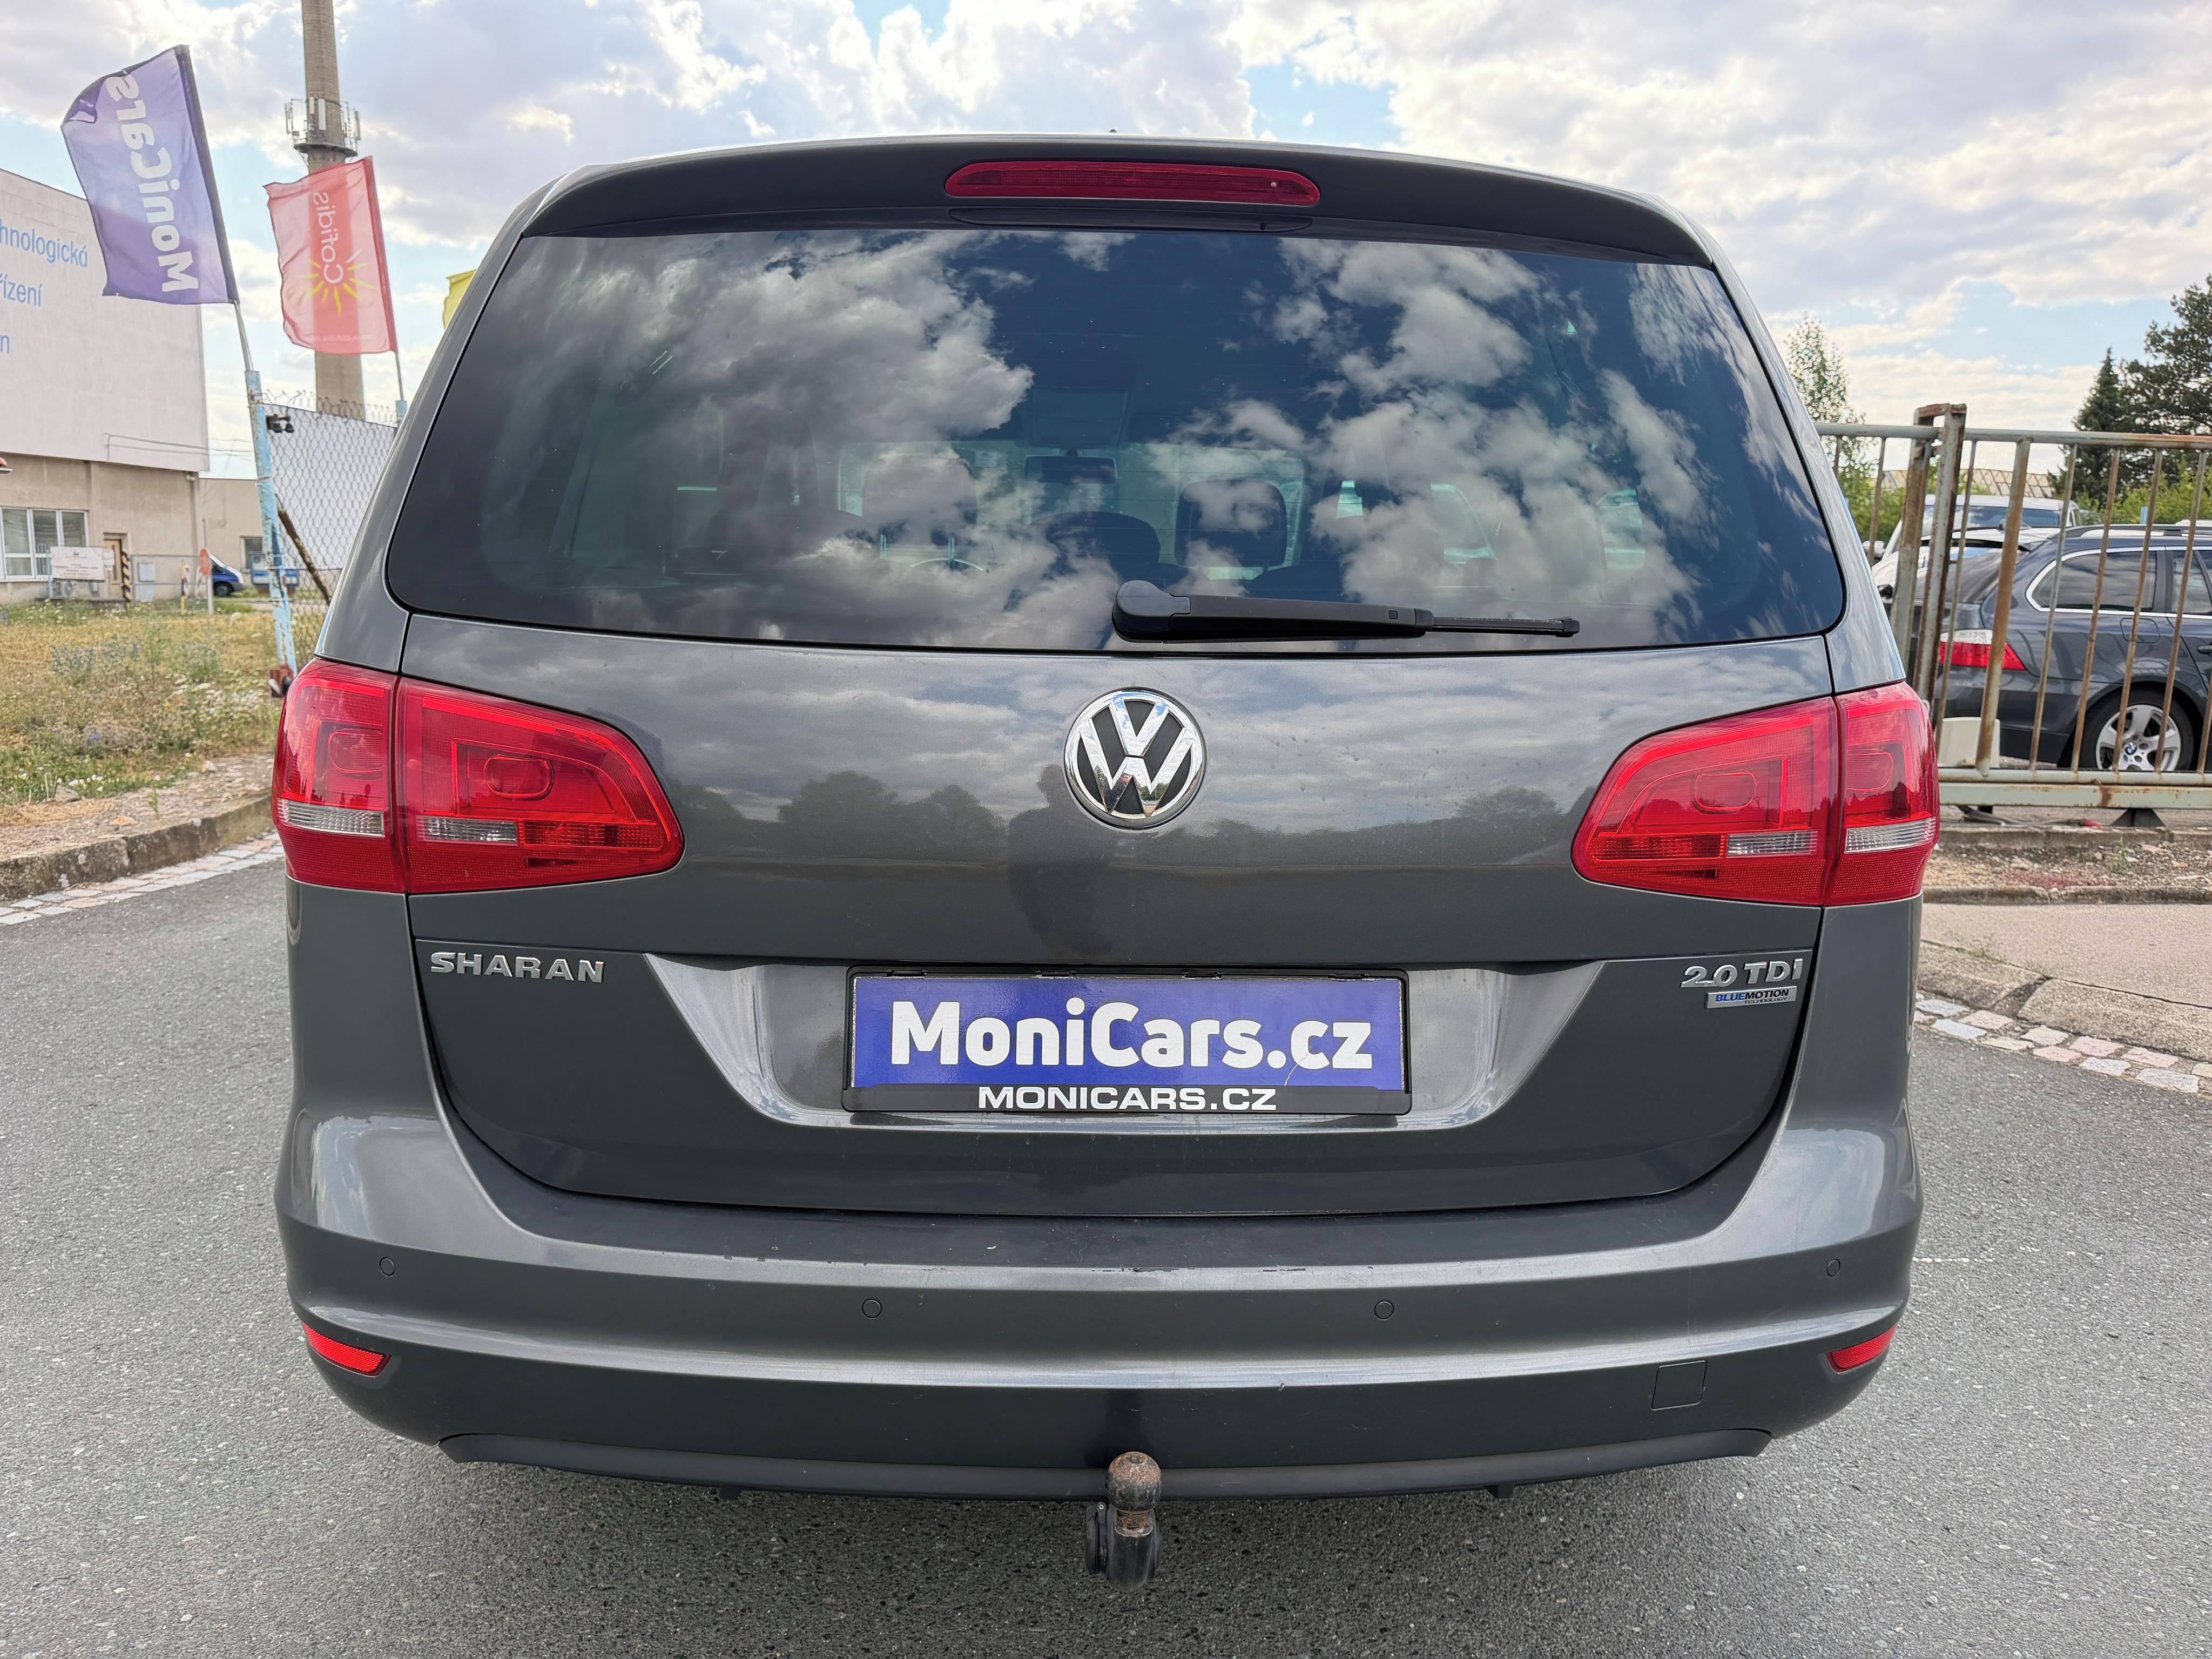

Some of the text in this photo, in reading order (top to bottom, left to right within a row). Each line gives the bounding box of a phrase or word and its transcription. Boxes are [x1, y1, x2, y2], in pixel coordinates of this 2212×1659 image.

[0, 273, 42, 307] ízení
[430, 952, 604, 983] SHARAN
[1744, 958, 1803, 984] TDI
[1715, 989, 1789, 1002] BLUEMOTION
[891, 997, 1372, 1070] MoniCars.cz
[978, 1086, 1277, 1111] MONICARS.CZ
